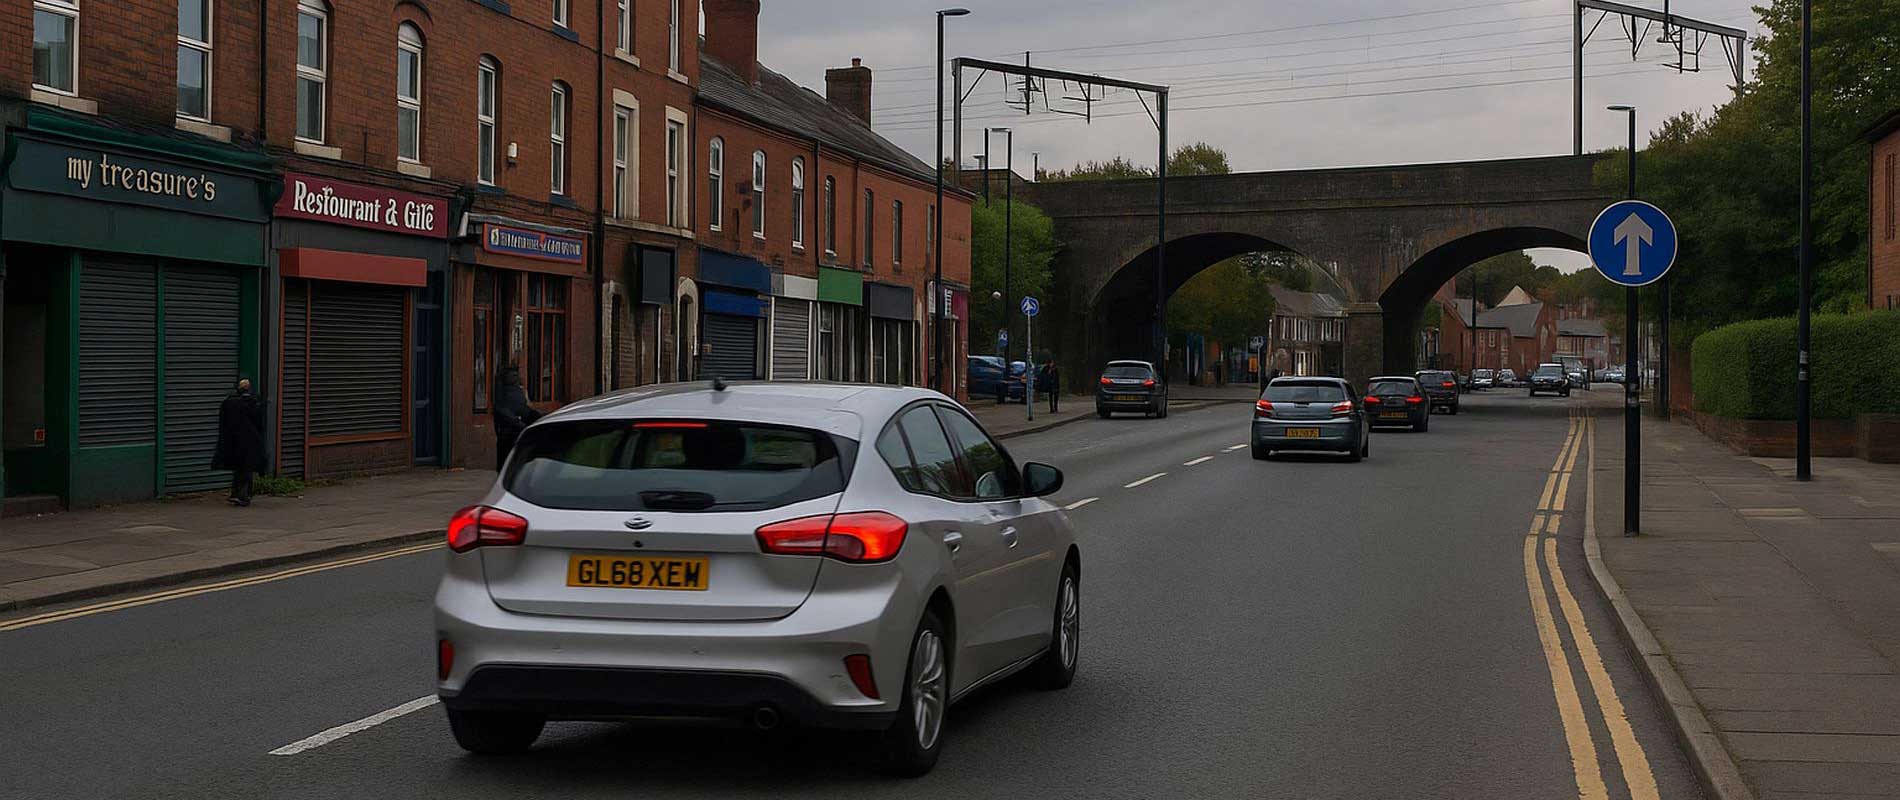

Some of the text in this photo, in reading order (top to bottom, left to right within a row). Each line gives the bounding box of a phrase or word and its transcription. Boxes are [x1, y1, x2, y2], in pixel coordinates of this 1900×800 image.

[67, 153, 216, 201] my treasure's
[578, 559, 644, 586] GL68
